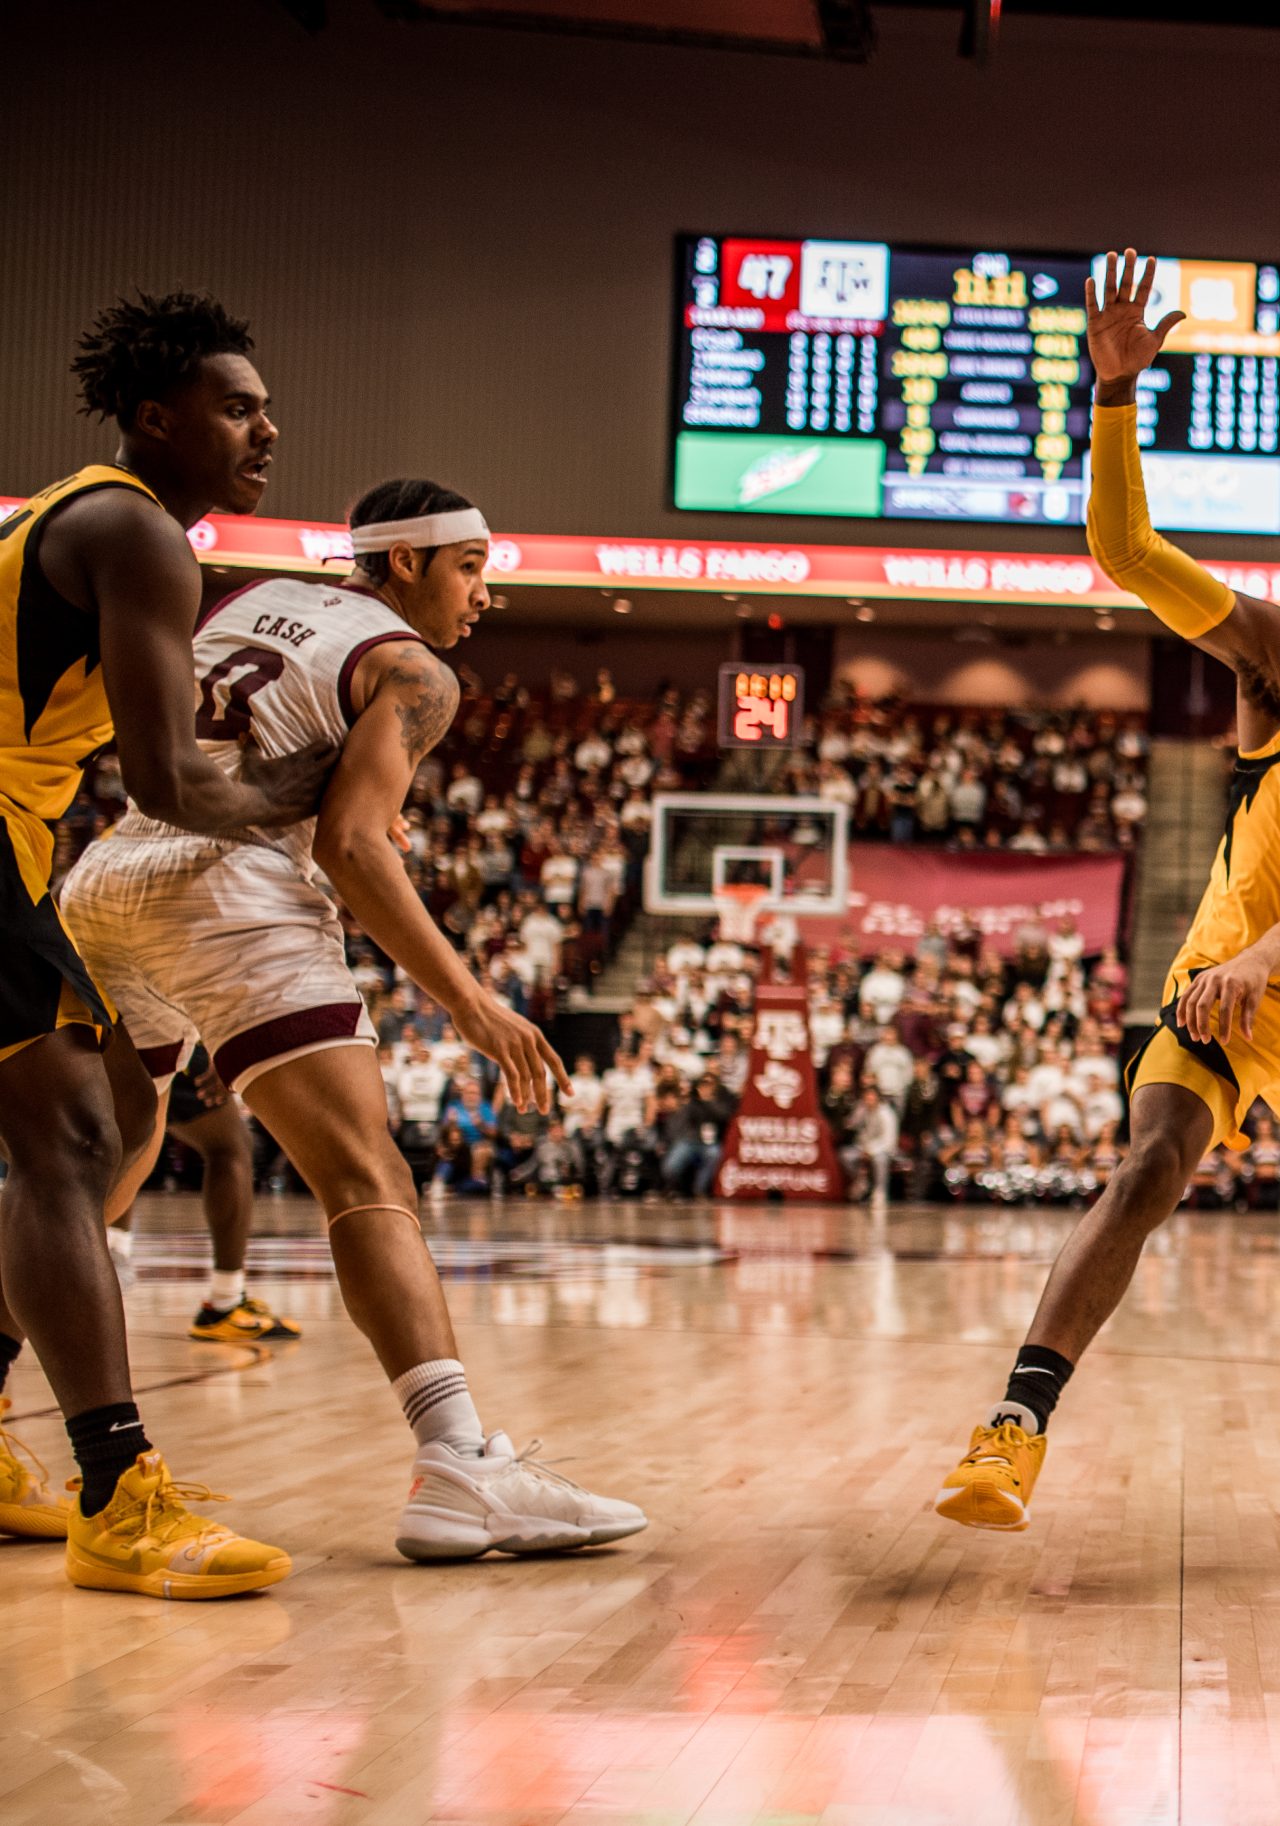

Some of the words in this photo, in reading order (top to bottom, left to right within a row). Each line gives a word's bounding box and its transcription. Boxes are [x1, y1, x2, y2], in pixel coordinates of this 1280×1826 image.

[738, 253, 793, 300] 47
[595, 544, 703, 578] WELLS
[705, 548, 811, 583] FARGO
[882, 555, 988, 590] WELLS
[252, 614, 316, 648] CASH
[734, 695, 788, 741] 24
[738, 1116, 819, 1142] WELLS
